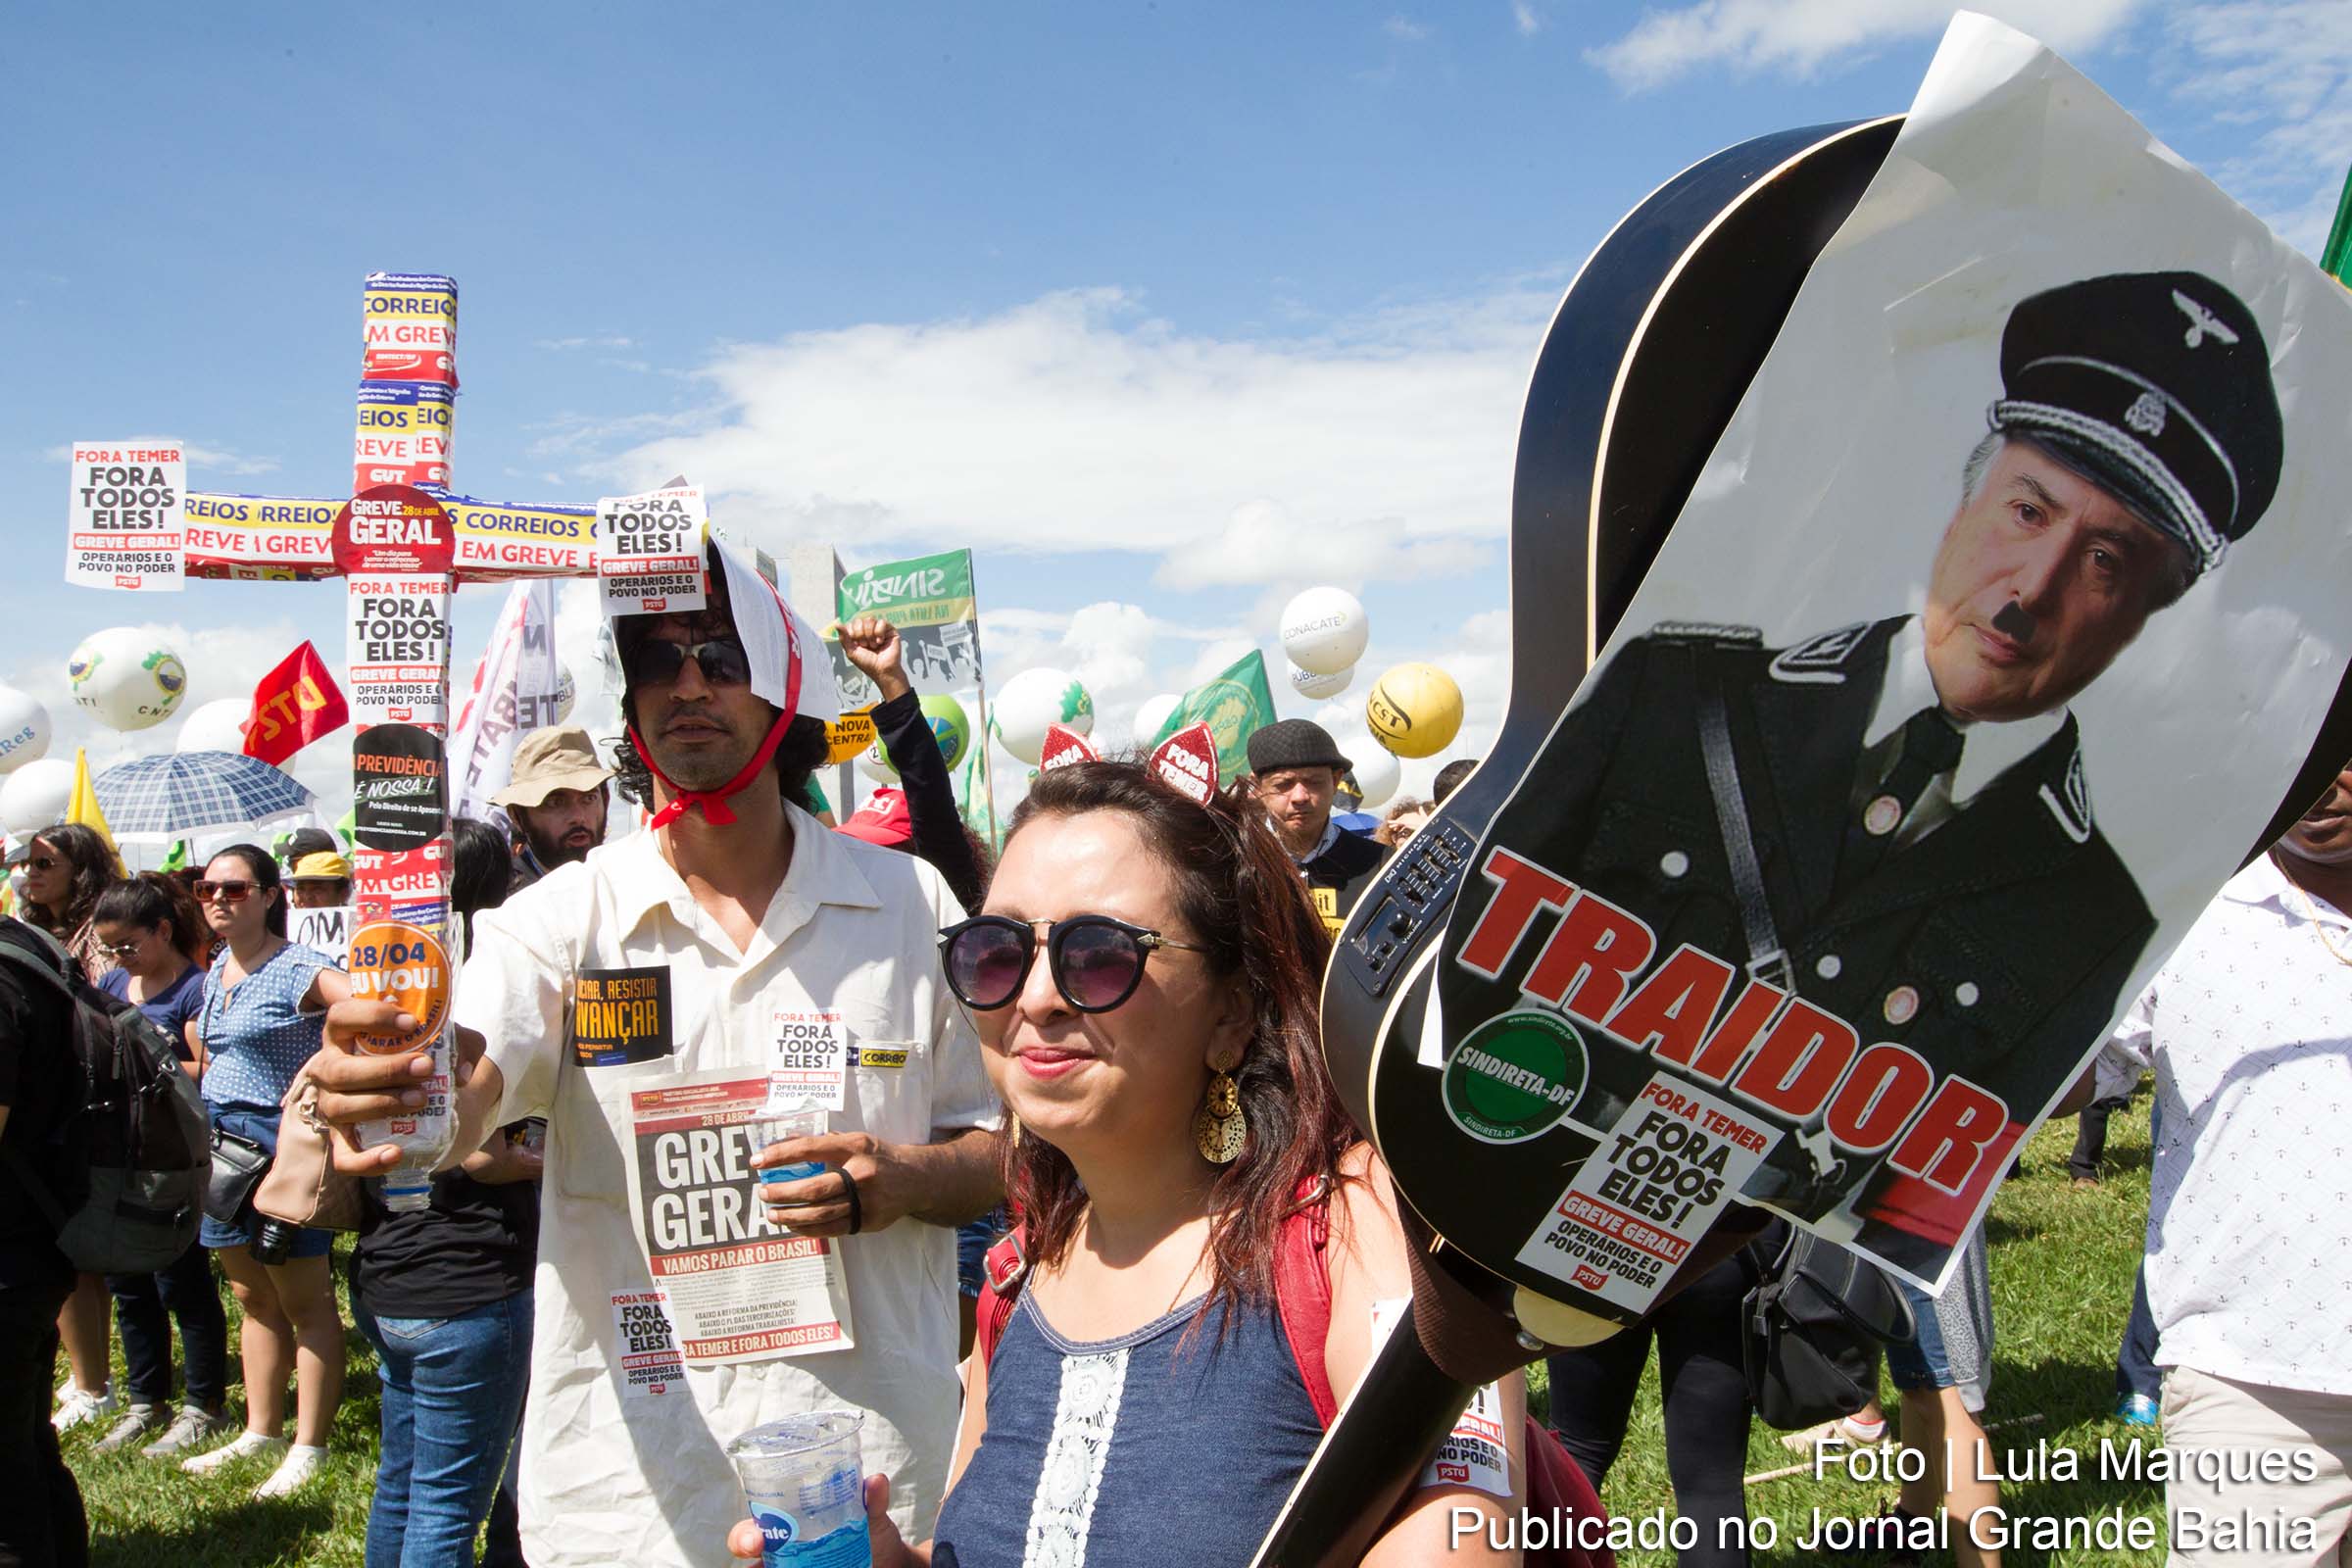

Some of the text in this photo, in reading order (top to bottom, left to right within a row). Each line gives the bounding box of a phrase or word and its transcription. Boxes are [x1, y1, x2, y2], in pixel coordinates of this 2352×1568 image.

[75, 449, 181, 464] FORA TEMER
[89, 466, 167, 487] FORA
[370, 468, 407, 483] CUT
[80, 488, 175, 509] TODOS
[351, 499, 403, 515] GREVE
[92, 510, 164, 530] ELES!
[466, 513, 579, 537] CORREIOS
[605, 514, 692, 534] TODOS
[350, 515, 442, 545] GERAL
[74, 535, 180, 549] GREVE GERAL!
[617, 533, 682, 555] ELES!
[82, 552, 172, 564] OPERÁRIOS E O
[462, 541, 577, 567] EM GREVE
[78, 562, 175, 573] POVO NO PODER
[603, 560, 698, 574] GREVE GERAL!
[350, 582, 449, 594] FORA TEMER
[611, 575, 693, 588] OPERÁRIOS E O
[609, 585, 697, 598] POVO NO PODER
[364, 599, 437, 618] FORA
[355, 619, 445, 640] TODOS
[367, 642, 434, 662] ELES!
[352, 668, 398, 680] GREVE
[358, 684, 423, 695] OPERÁRIOS
[425, 685, 432, 694] E
[388, 696, 404, 705] NO
[835, 720, 870, 733] NOVA
[358, 754, 441, 777] PREVIDÊNCIA
[1166, 743, 1209, 780] FORA
[354, 781, 366, 799] É
[368, 777, 420, 799] NOSSA
[354, 943, 425, 968] 28/04
[370, 967, 439, 993] VOU!
[608, 978, 657, 999] RESISTIR
[774, 1013, 841, 1022] FORA TEMER
[1455, 845, 2010, 1198] TRAIDOR
[783, 1025, 832, 1039] FORA
[777, 1040, 838, 1054] TODOS
[784, 1055, 830, 1068] ELES!
[1457, 1047, 1575, 1105] SINDIRETA-DF
[702, 1114, 724, 1126] 28 DE
[1463, 1116, 1516, 1137] SINDIRETA-DF
[1641, 1081, 1768, 1154] FORA TEMER
[1634, 1110, 1731, 1176] FORA
[1607, 1134, 1725, 1206] TODOS
[1597, 1168, 1694, 1229] ELES!
[1563, 1196, 1689, 1259] GREVE GERAL!
[662, 1239, 817, 1274] VAMOS PARAR O BRASIL!
[1557, 1220, 1663, 1274] OPERÁRIOS E O
[1544, 1232, 1656, 1289] POVO NO PODER
[1576, 1269, 1602, 1286] PSTU
[612, 1294, 667, 1305] FORA TEMER
[622, 1305, 664, 1321] FORA
[619, 1320, 672, 1338] TODOS
[629, 1335, 671, 1352] ELES!
[697, 1339, 730, 1355] TEMER
[730, 1340, 737, 1349] E
[739, 1335, 768, 1351] FORA
[769, 1330, 806, 1347] TODOS
[807, 1326, 834, 1342] ELES!
[623, 1352, 683, 1367] GREVE GERAL!
[628, 1366, 669, 1377] OPERÁRIOS
[628, 1376, 647, 1385] POVO
[660, 1373, 684, 1382] PODER
[1482, 1441, 1498, 1457] E O
[1438, 1447, 1502, 1473] NO PODER
[1442, 1467, 1465, 1478] PSTU
